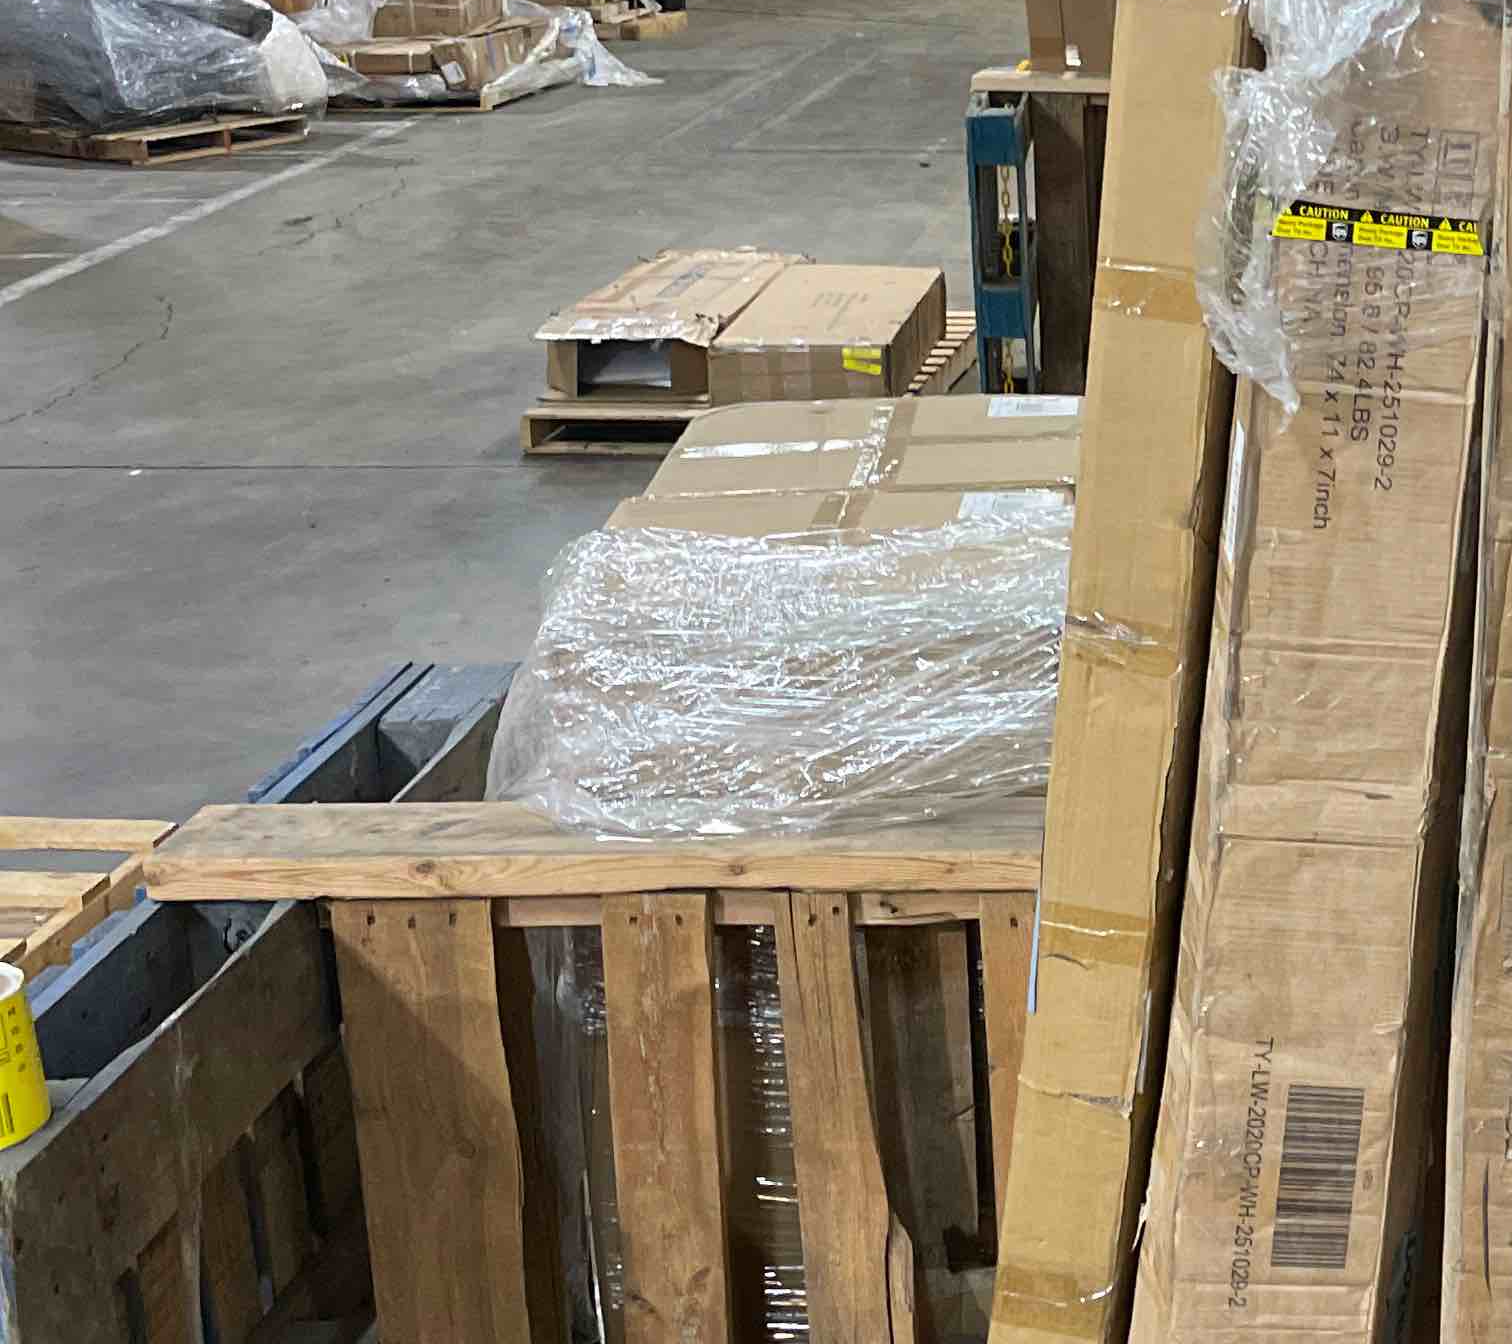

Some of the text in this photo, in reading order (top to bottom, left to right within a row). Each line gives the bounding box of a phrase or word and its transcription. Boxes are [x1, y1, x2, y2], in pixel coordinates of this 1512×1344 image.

[1299, 206, 1350, 220] CAUTION
[1380, 214, 1430, 229] CAUTION
[1322, 413, 1341, 440] 11
[1313, 467, 1337, 530] 7inch
